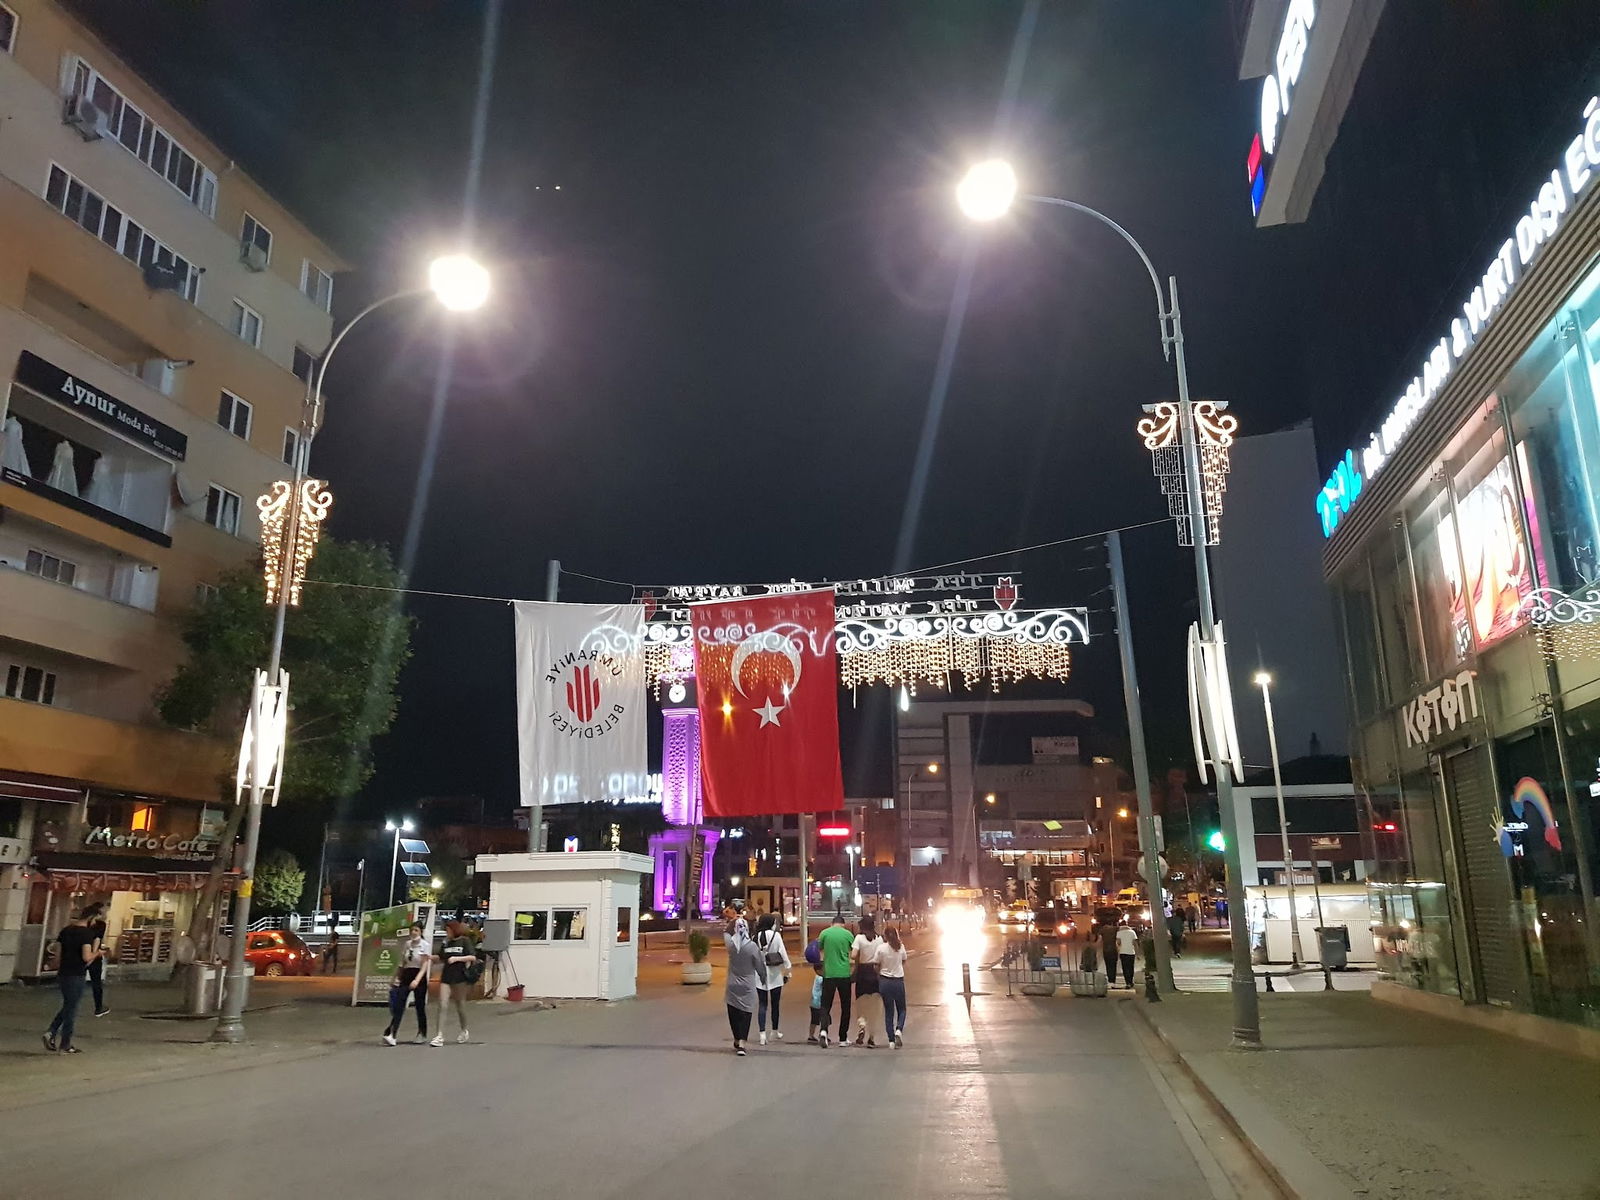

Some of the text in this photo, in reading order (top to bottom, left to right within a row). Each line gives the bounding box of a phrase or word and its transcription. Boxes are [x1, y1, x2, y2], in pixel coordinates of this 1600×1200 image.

[1463, 238, 1514, 335] YURT
[1516, 169, 1567, 265] DIŞI
[61, 376, 117, 416] Aynur
[117, 410, 141, 430] Moda
[85, 826, 157, 850] Metro
